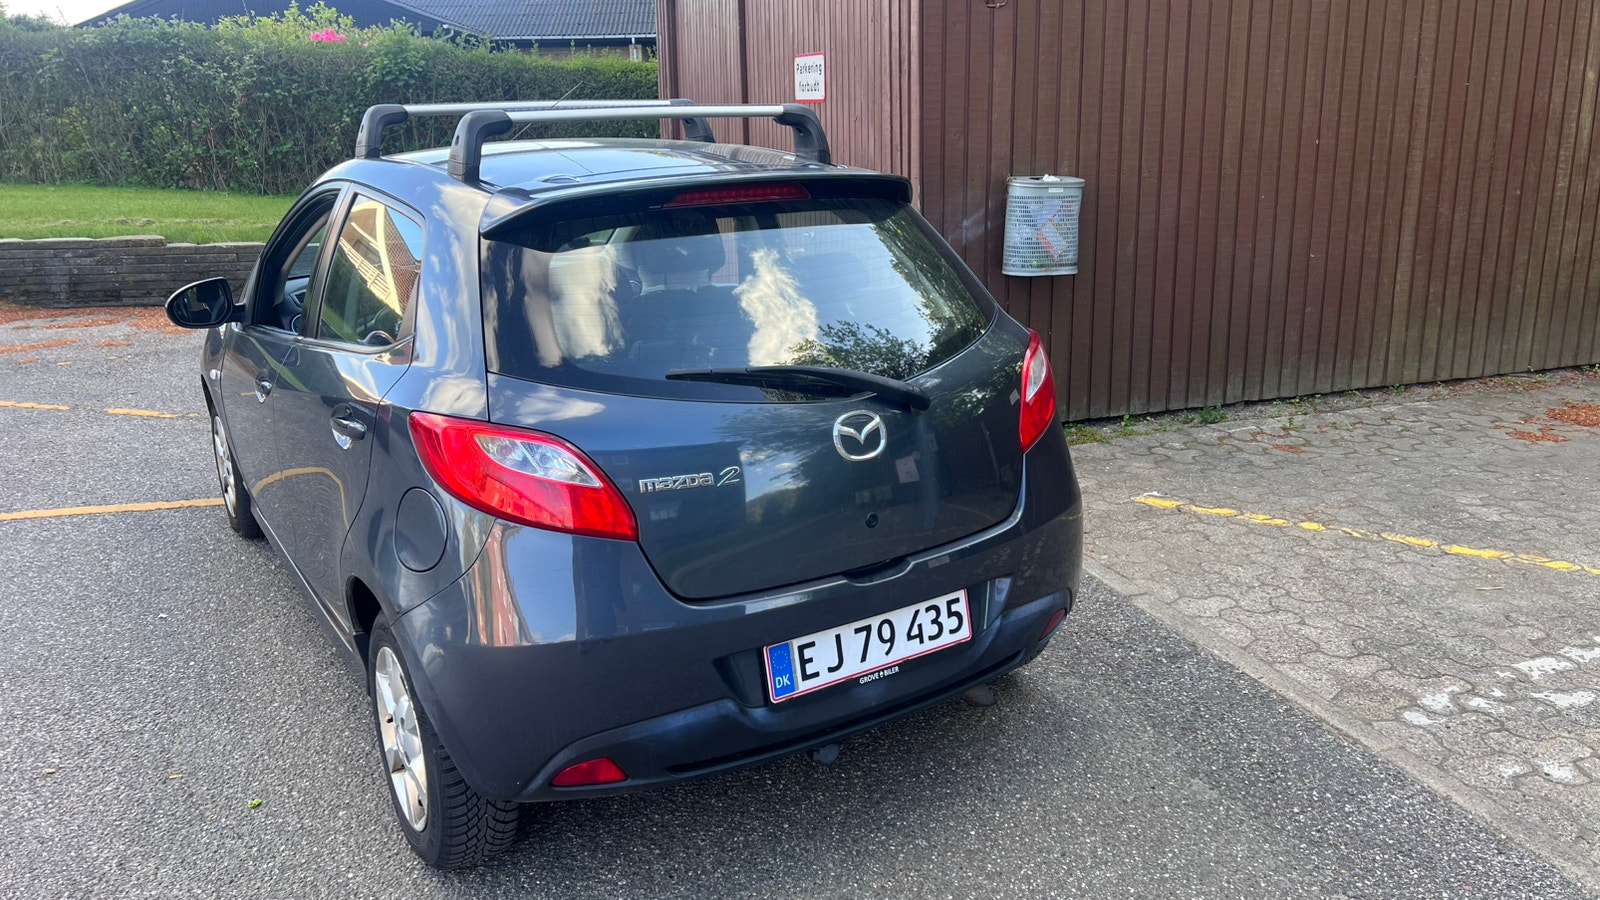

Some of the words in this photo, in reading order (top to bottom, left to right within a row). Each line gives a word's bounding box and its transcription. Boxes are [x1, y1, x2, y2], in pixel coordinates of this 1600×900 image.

[796, 62, 822, 75] Parkering
[799, 81, 819, 92] forbudt
[717, 466, 740, 487] 2
[797, 633, 844, 682] EJ
[854, 618, 896, 663] 79
[906, 597, 964, 645] 435
[775, 675, 791, 689] DK
[859, 672, 879, 684] GROVE
[883, 665, 900, 677] BILER
